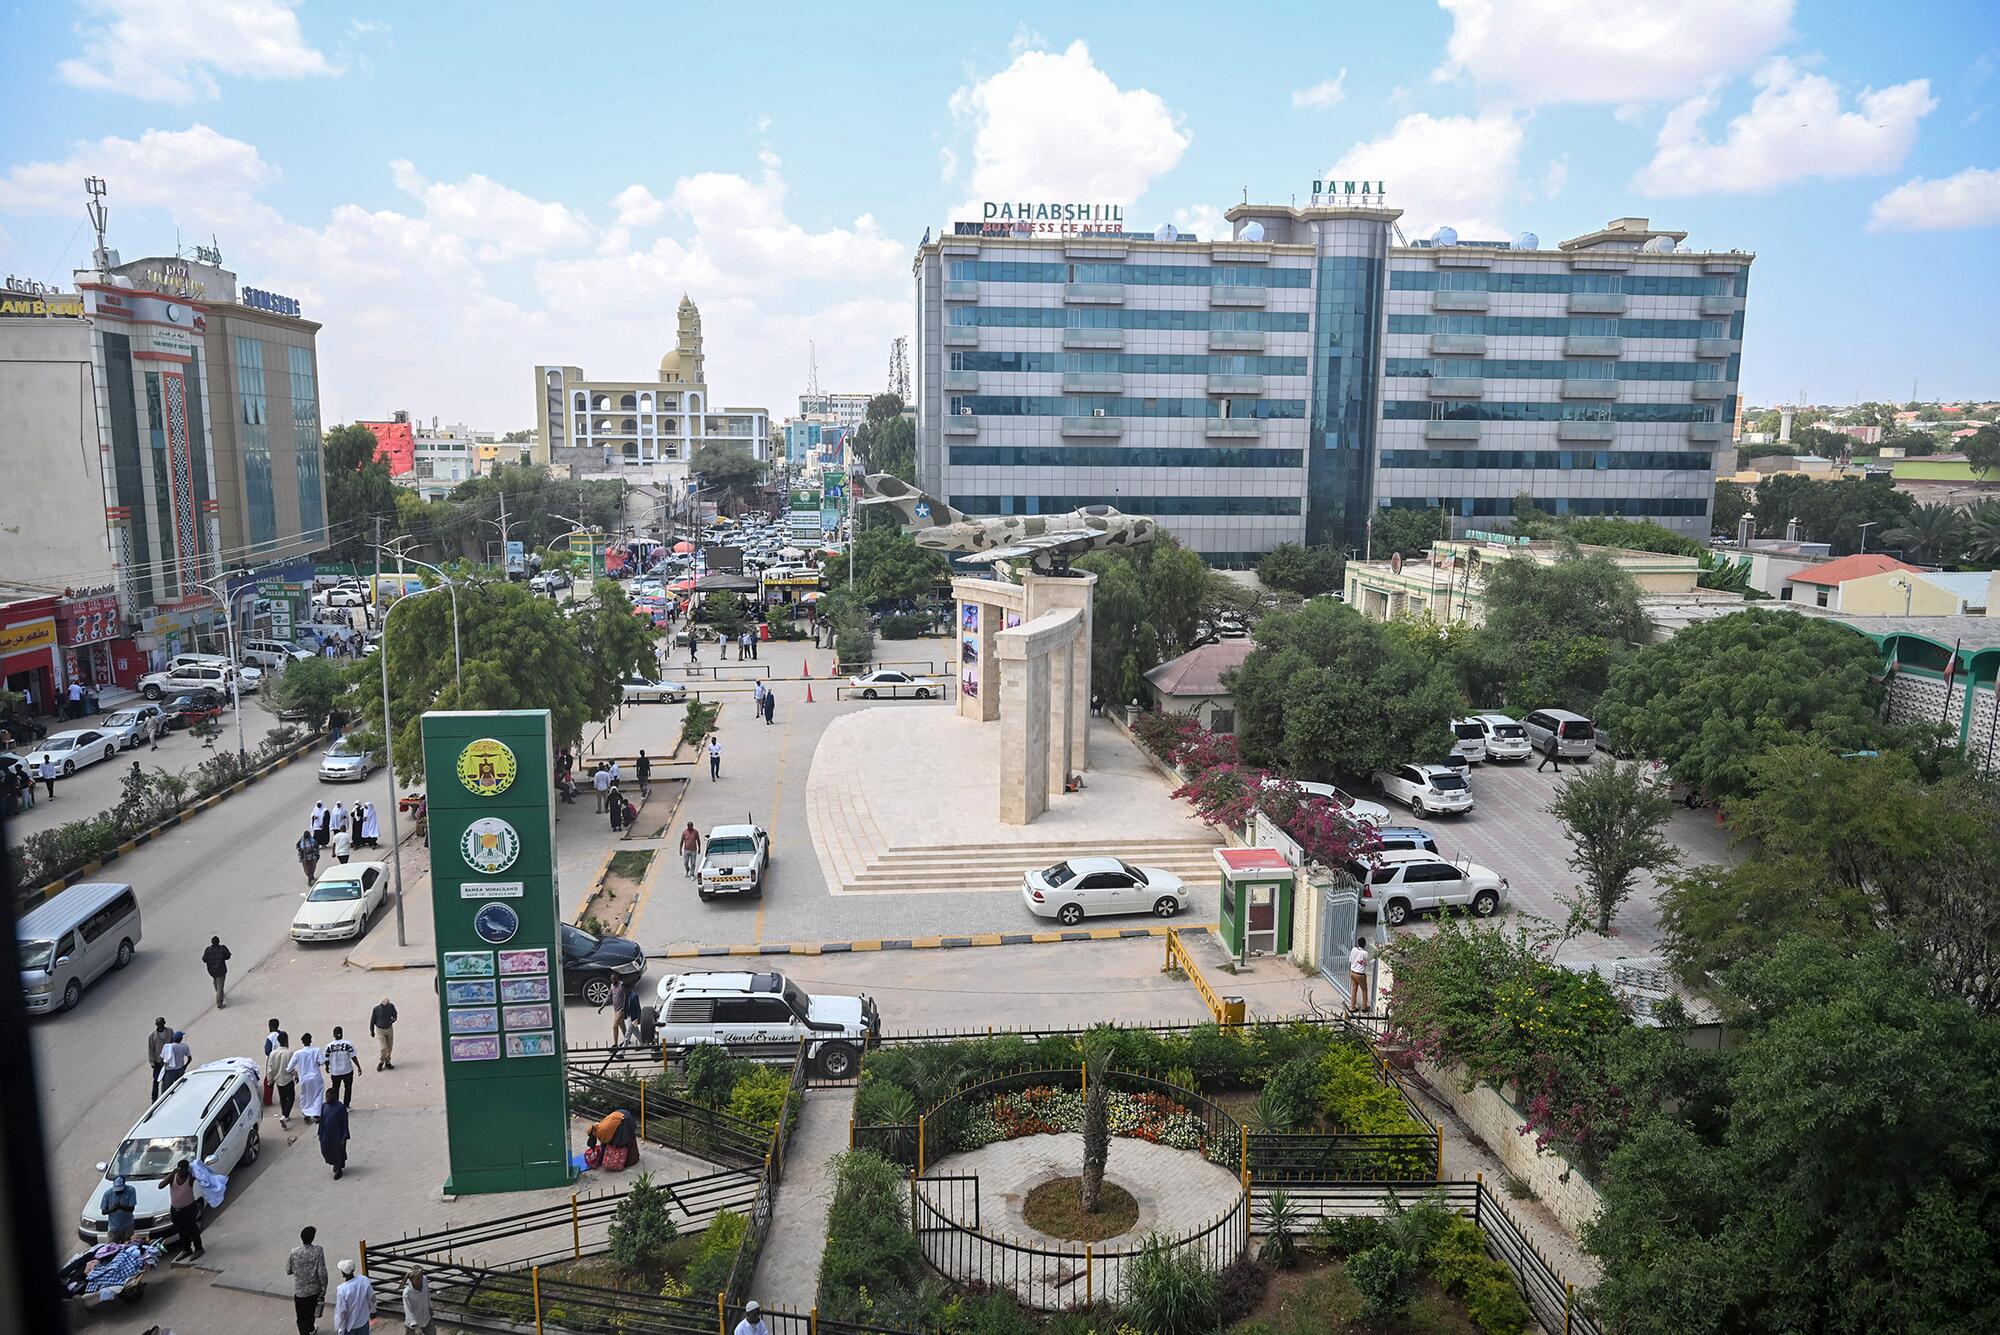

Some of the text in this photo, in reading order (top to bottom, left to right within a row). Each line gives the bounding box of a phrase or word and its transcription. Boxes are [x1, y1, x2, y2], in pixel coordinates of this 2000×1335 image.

[1313, 180, 1385, 194] DAMAL
[1311, 195, 1383, 204] HOTEL
[984, 202, 1122, 220] DAHABSHIIL
[982, 222, 1122, 233] BUSINESS CENTER
[242, 286, 302, 318] SAMSUNG
[725, 1033, 795, 1043] Land Cruiser
